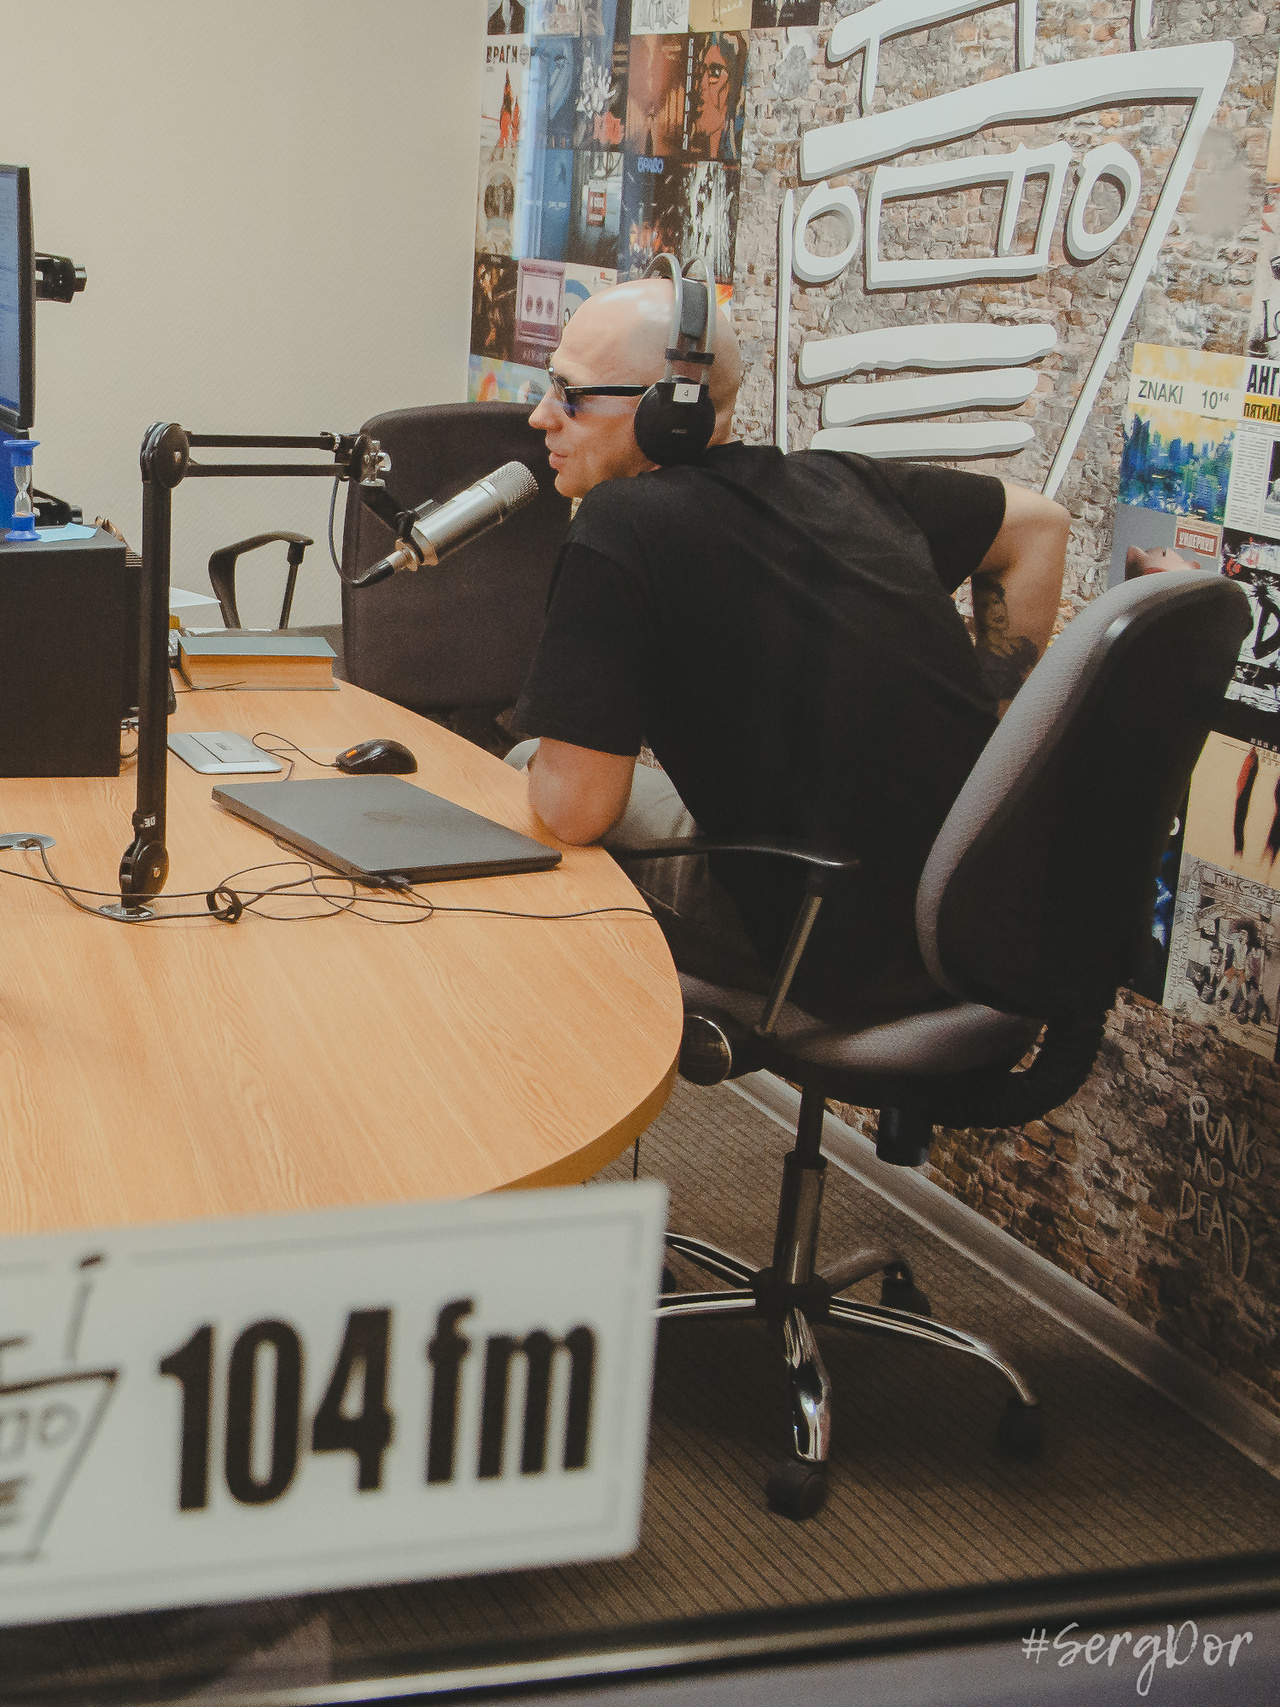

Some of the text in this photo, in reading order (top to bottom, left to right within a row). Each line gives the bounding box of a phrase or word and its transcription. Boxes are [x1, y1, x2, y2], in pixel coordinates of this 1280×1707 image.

[1138, 380, 1184, 404] ZNAKI
[1246, 364, 1280, 395] АНГ
[1179, 1180, 1250, 1282] DEAD
[158, 1297, 597, 1513] 104 fm
